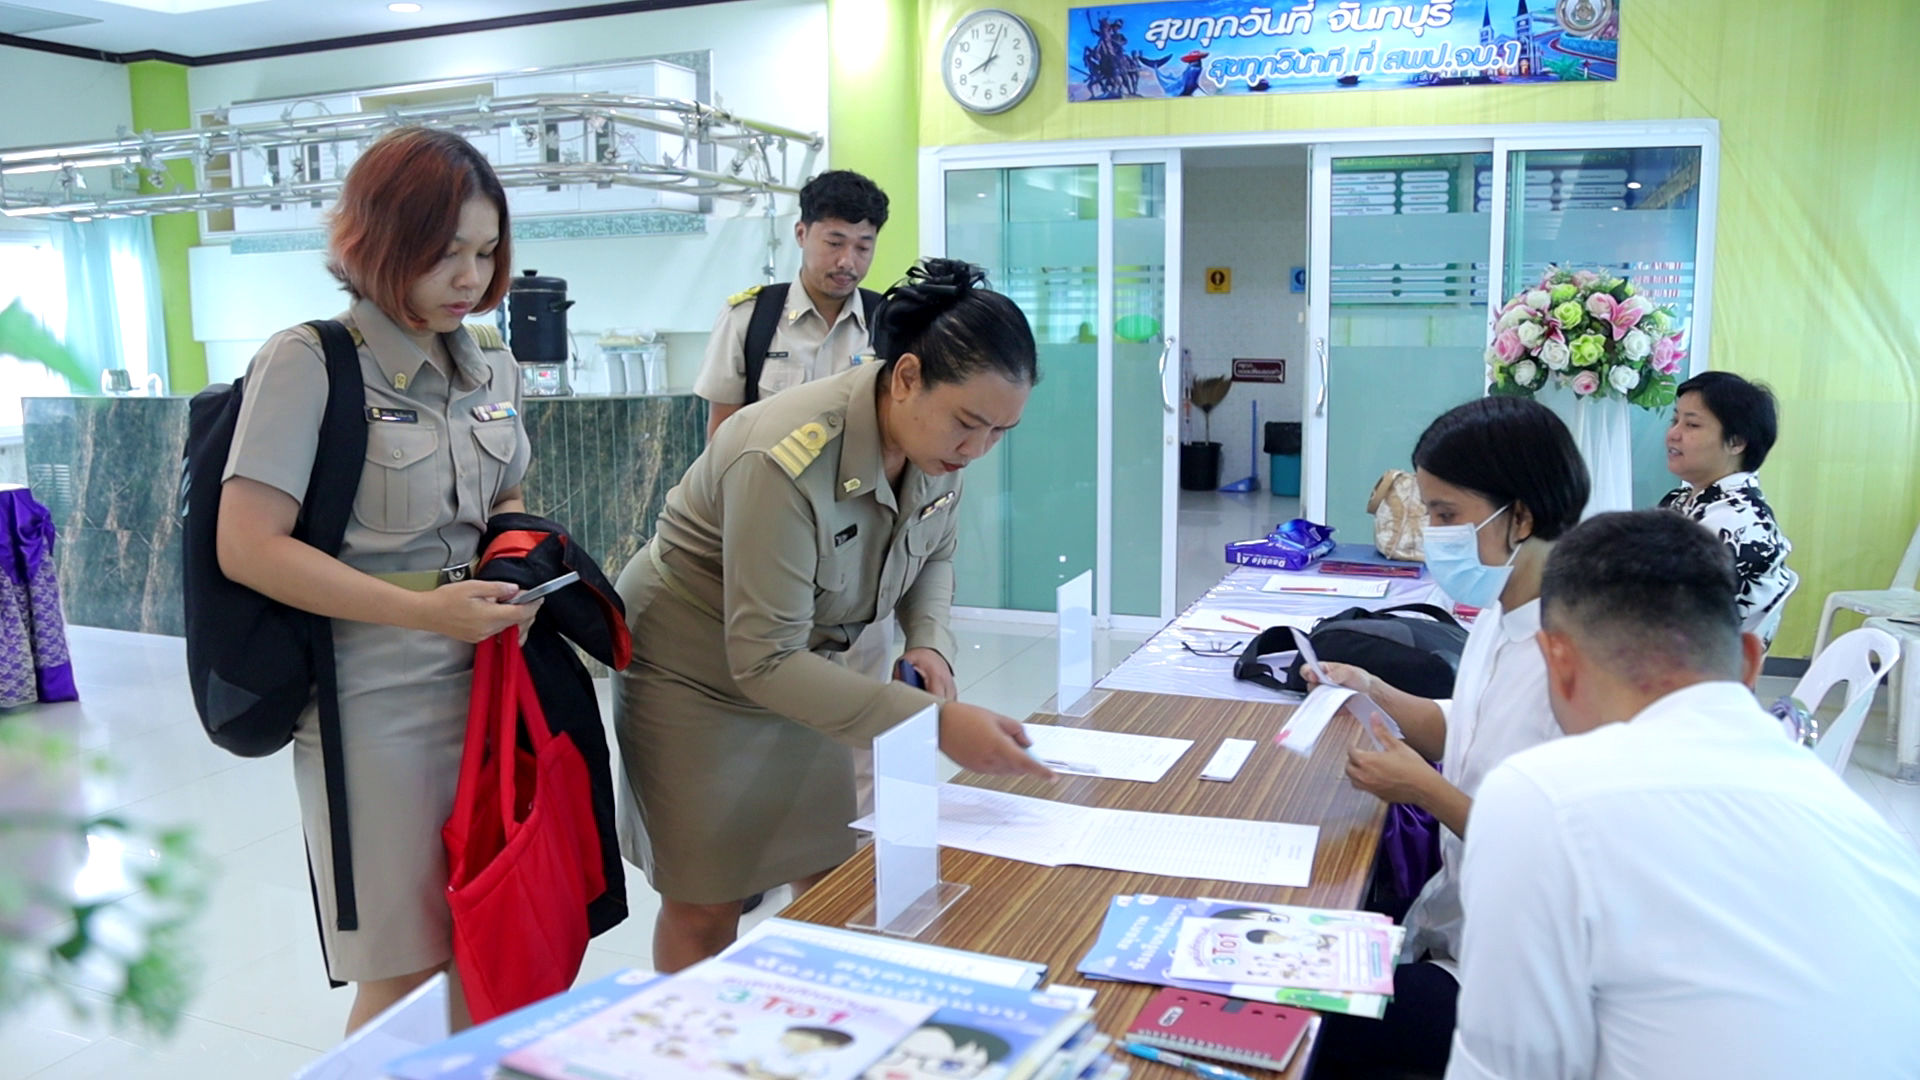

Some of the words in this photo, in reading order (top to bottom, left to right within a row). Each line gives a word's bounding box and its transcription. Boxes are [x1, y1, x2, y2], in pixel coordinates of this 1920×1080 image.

[985, 23, 996, 34] 12
[1003, 27, 1008, 38] 1
[971, 29, 980, 40] 11
[959, 41, 970, 52] 10
[1013, 38, 1021, 50] 2
[954, 58, 962, 69] 9
[1017, 54, 1024, 66] 3
[1208, 46, 1346, 86] สุขทุกวินาที
[1353, 39, 1377, 71] ที่
[1383, 41, 1521, 71] สพป.จบ.1
[959, 74, 967, 86] 8
[1011, 72, 1019, 83] 4
[971, 85, 978, 97] 7
[984, 89, 993, 100] 6
[1000, 84, 1007, 95] 5
[1242, 556, 1251, 564] A
[1251, 556, 1286, 568] Double
